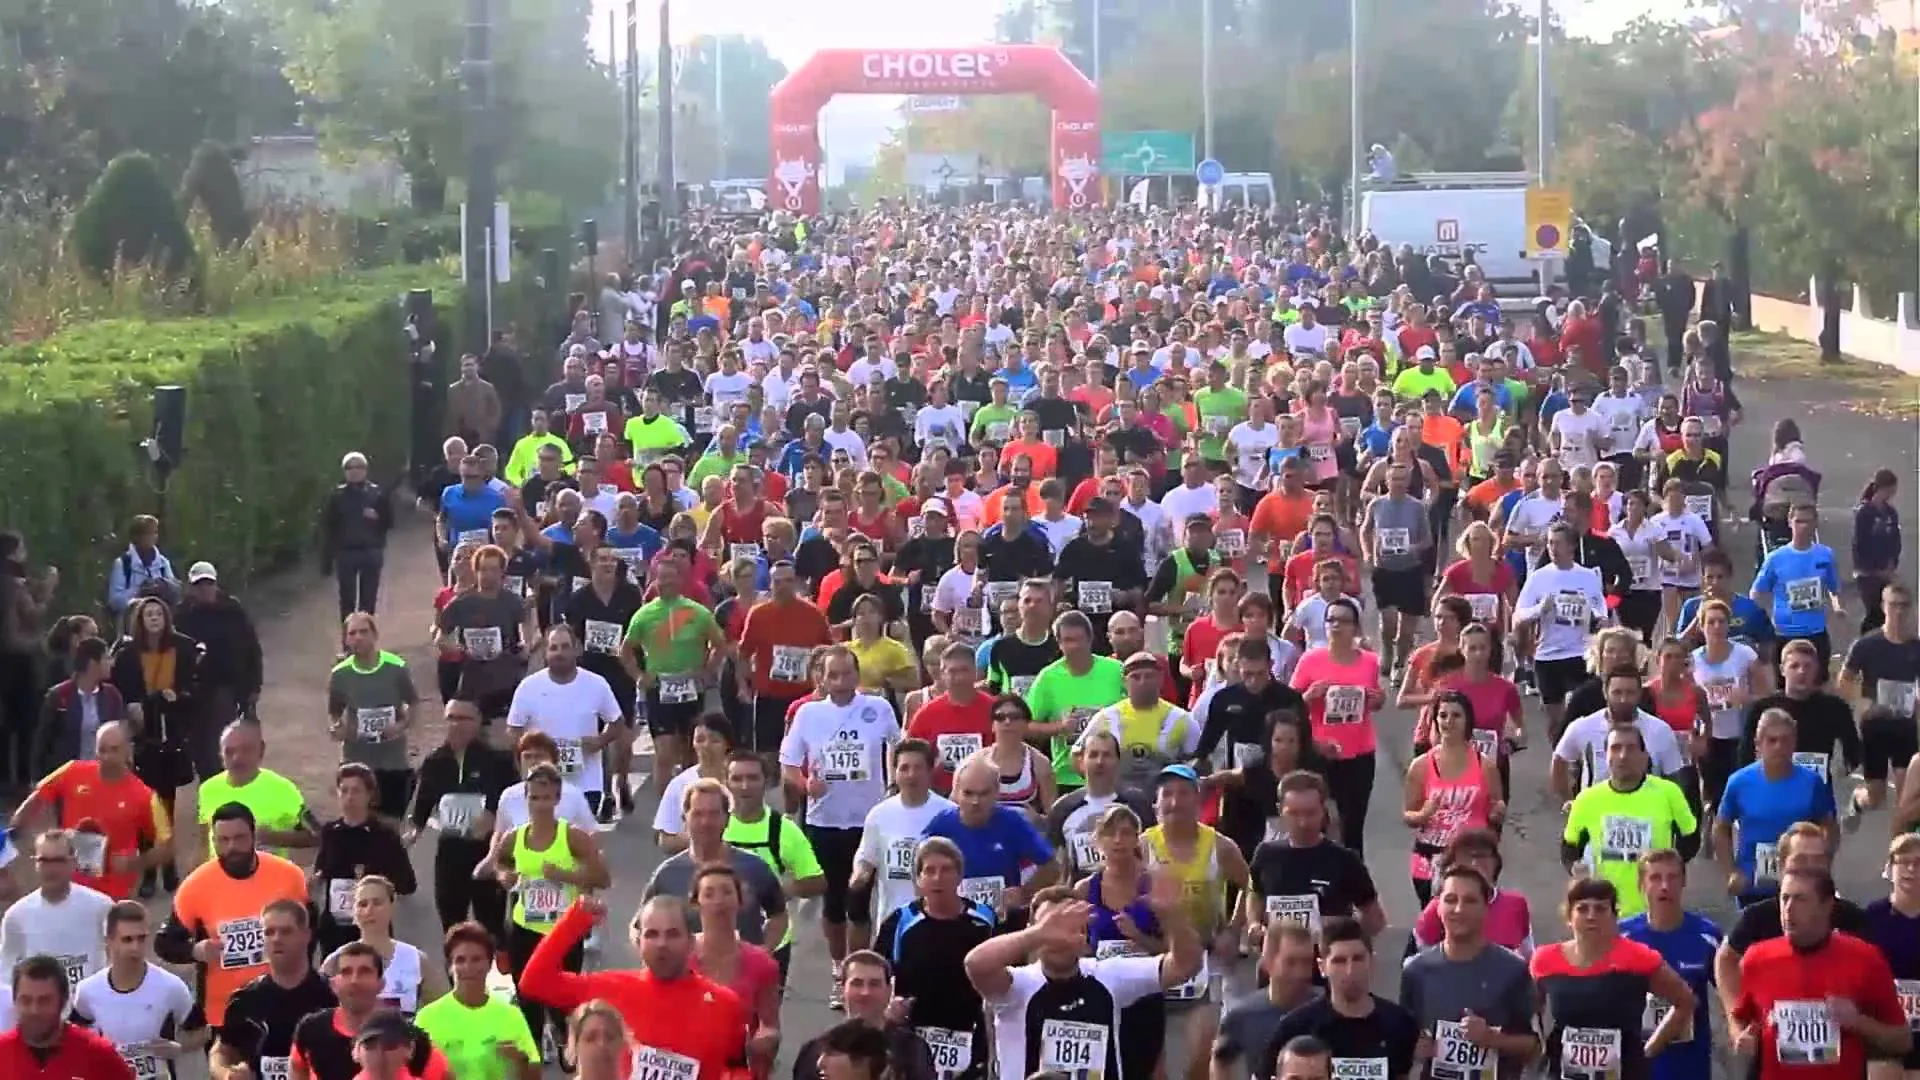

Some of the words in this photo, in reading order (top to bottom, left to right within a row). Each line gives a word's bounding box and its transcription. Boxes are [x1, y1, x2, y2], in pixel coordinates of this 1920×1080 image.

[830, 751, 860, 769] 1476
[227, 931, 264, 953] 2925
[1047, 1026, 1058, 1038] LA
[1059, 1027, 1103, 1041] CHOLETAISE
[1787, 1021, 1828, 1043] 2001
[1055, 1040, 1091, 1065] 1814
[1570, 1045, 1609, 1067] 2012
